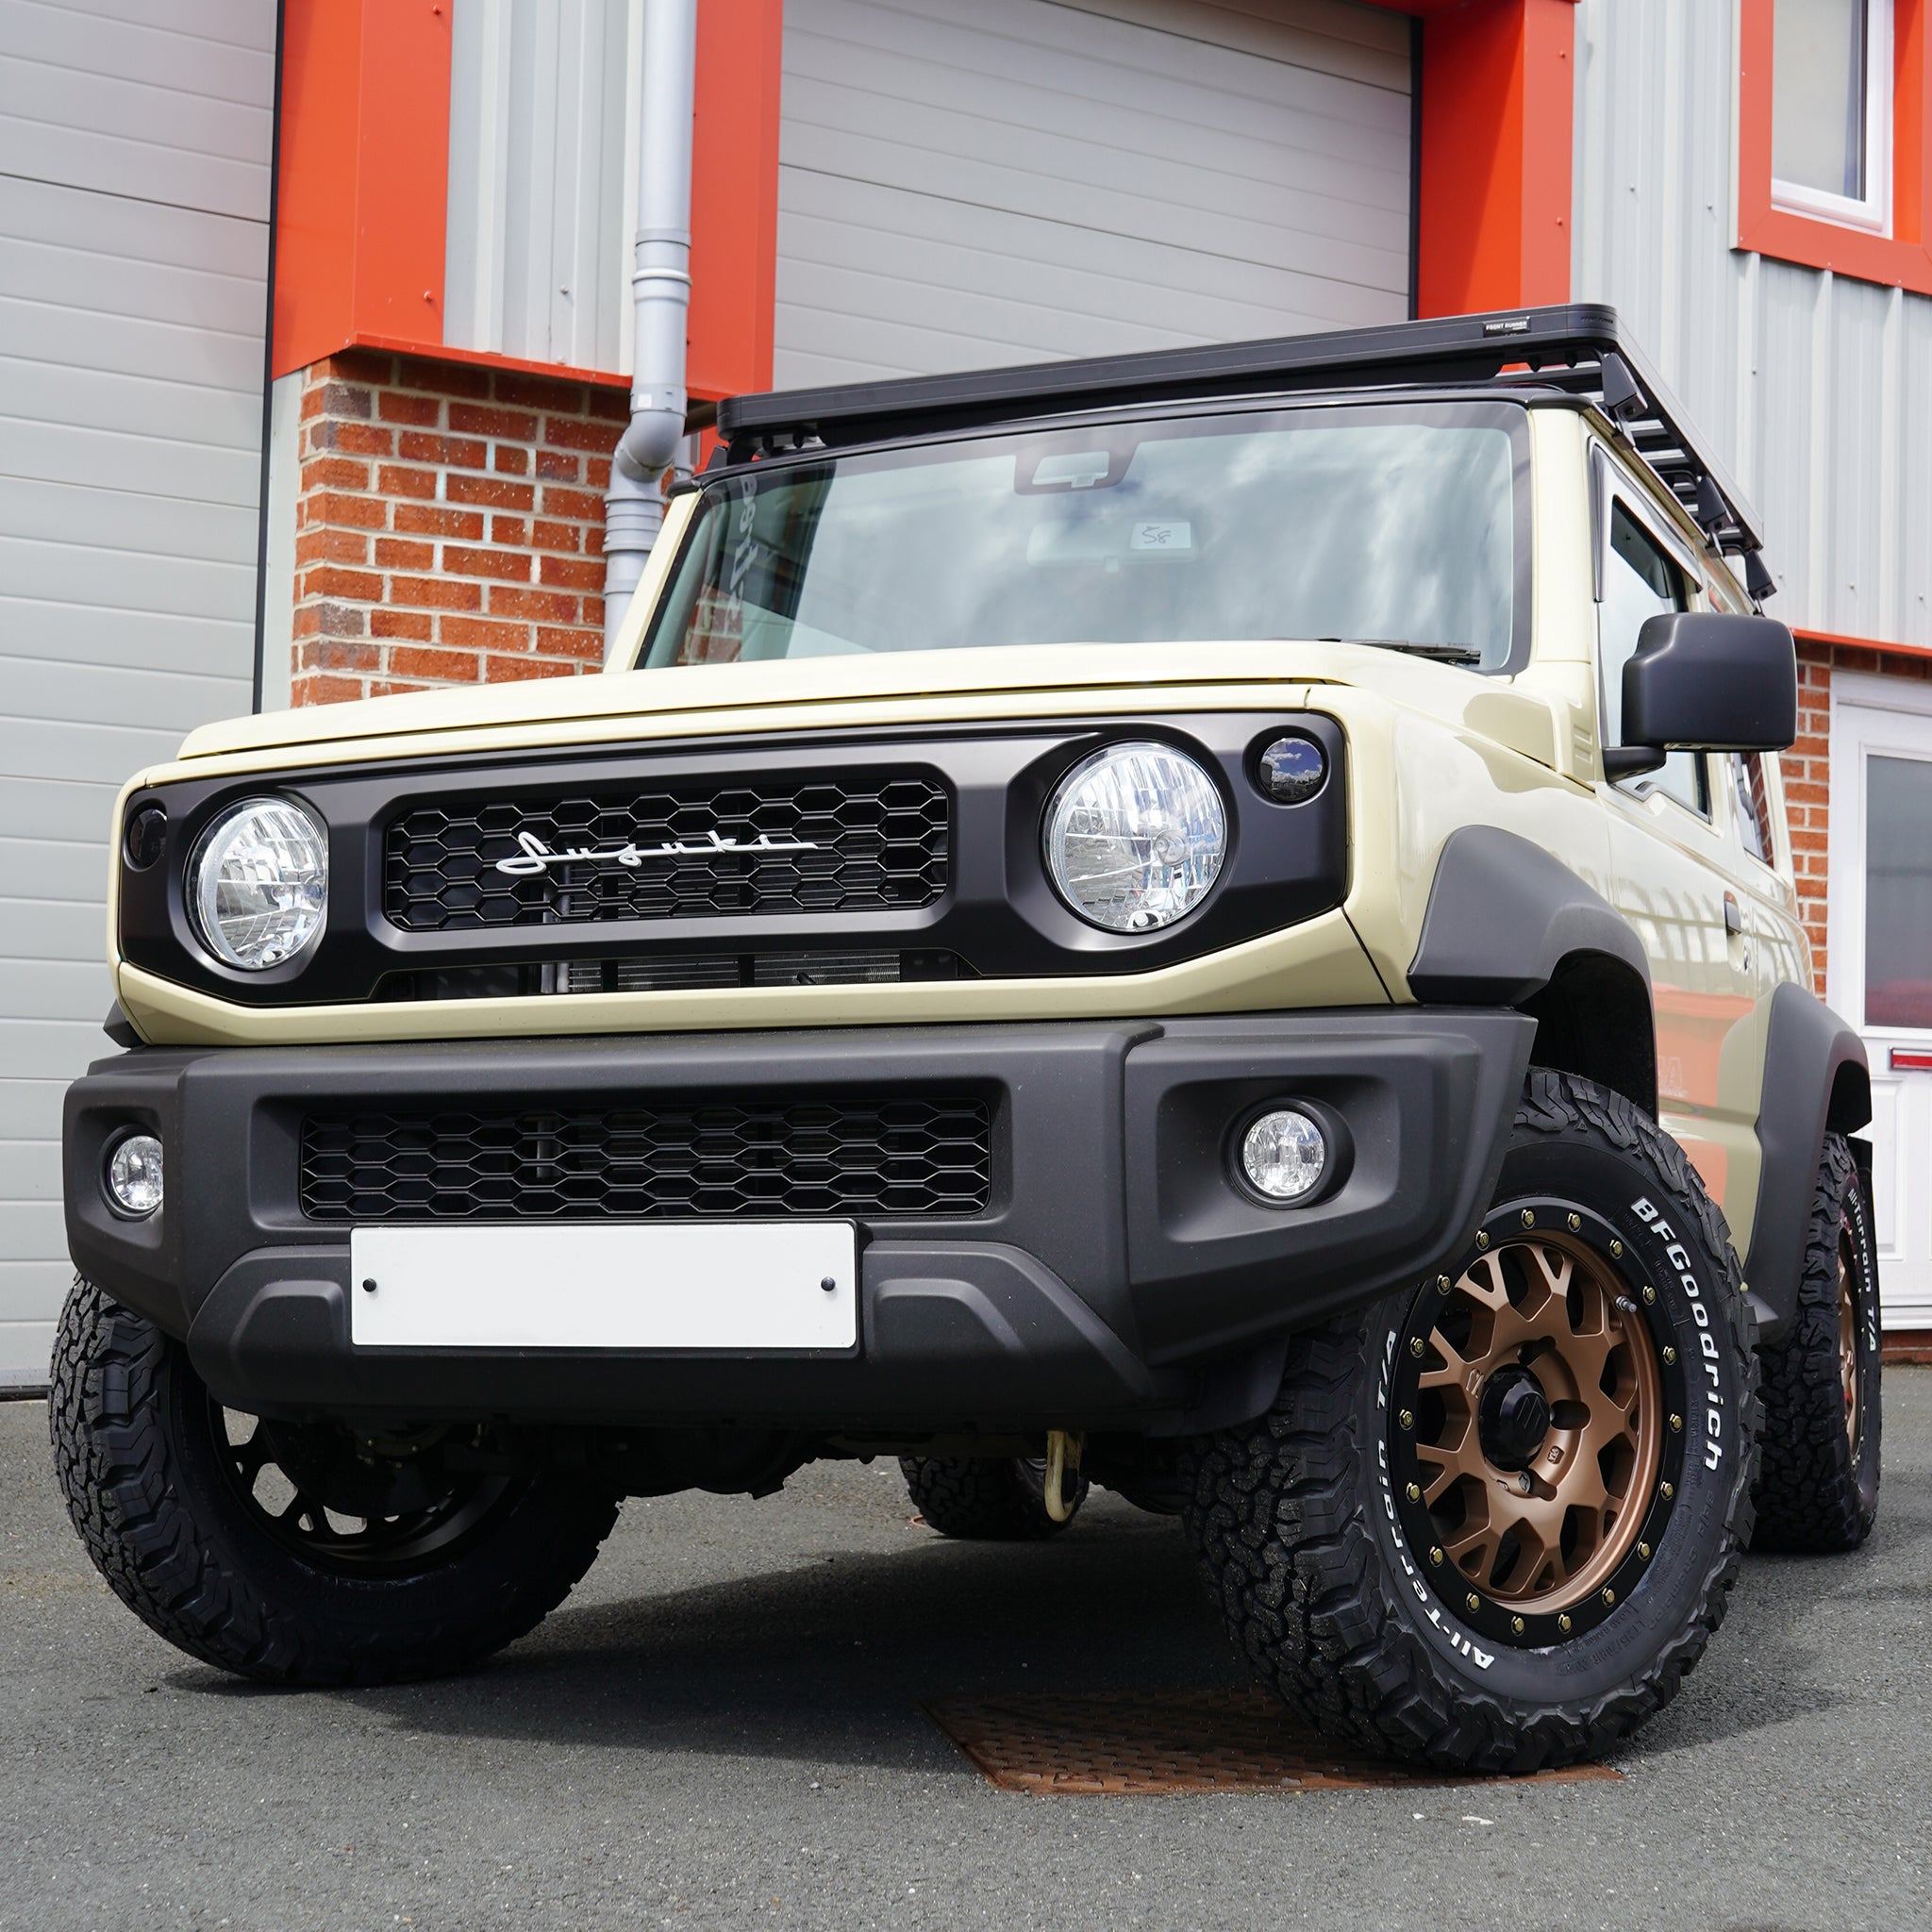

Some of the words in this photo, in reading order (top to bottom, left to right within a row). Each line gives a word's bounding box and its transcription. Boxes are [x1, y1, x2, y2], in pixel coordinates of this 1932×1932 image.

[1375, 1329, 1398, 1410] T/A
[1630, 1195, 1724, 1472] BFGoodrich
[1846, 1188, 1873, 1293] All-Terrain
[1866, 1305, 1878, 1353] T/A
[1377, 1439, 1496, 1671] All-Terrain
